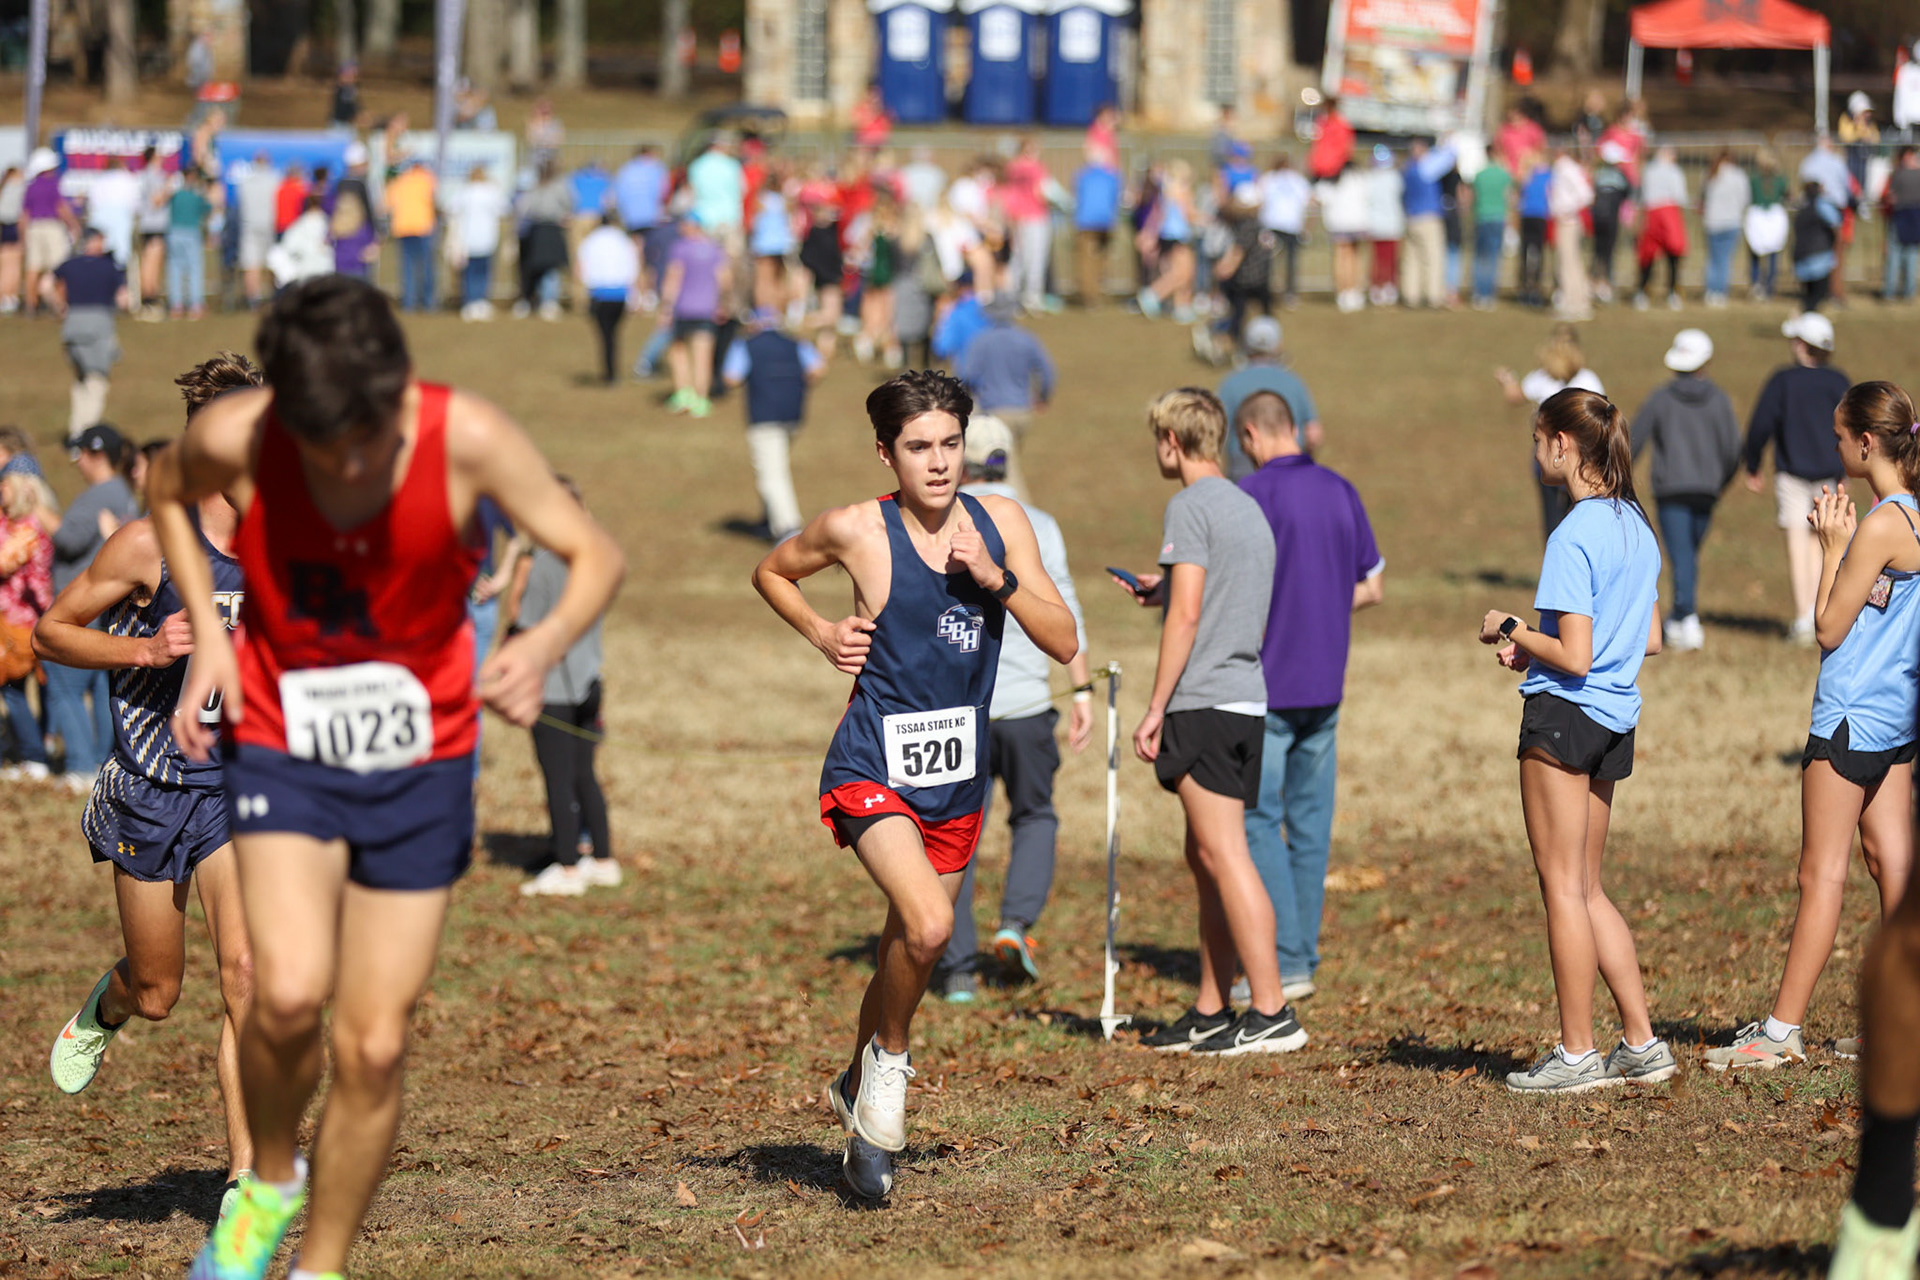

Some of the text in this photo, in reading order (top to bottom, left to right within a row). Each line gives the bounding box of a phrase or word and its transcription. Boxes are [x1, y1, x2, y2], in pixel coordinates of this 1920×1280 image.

[938, 614, 980, 652] SBA
[302, 702, 415, 764] 1023
[895, 716, 966, 735] TSSAA STATE XC
[902, 737, 963, 777] 520
